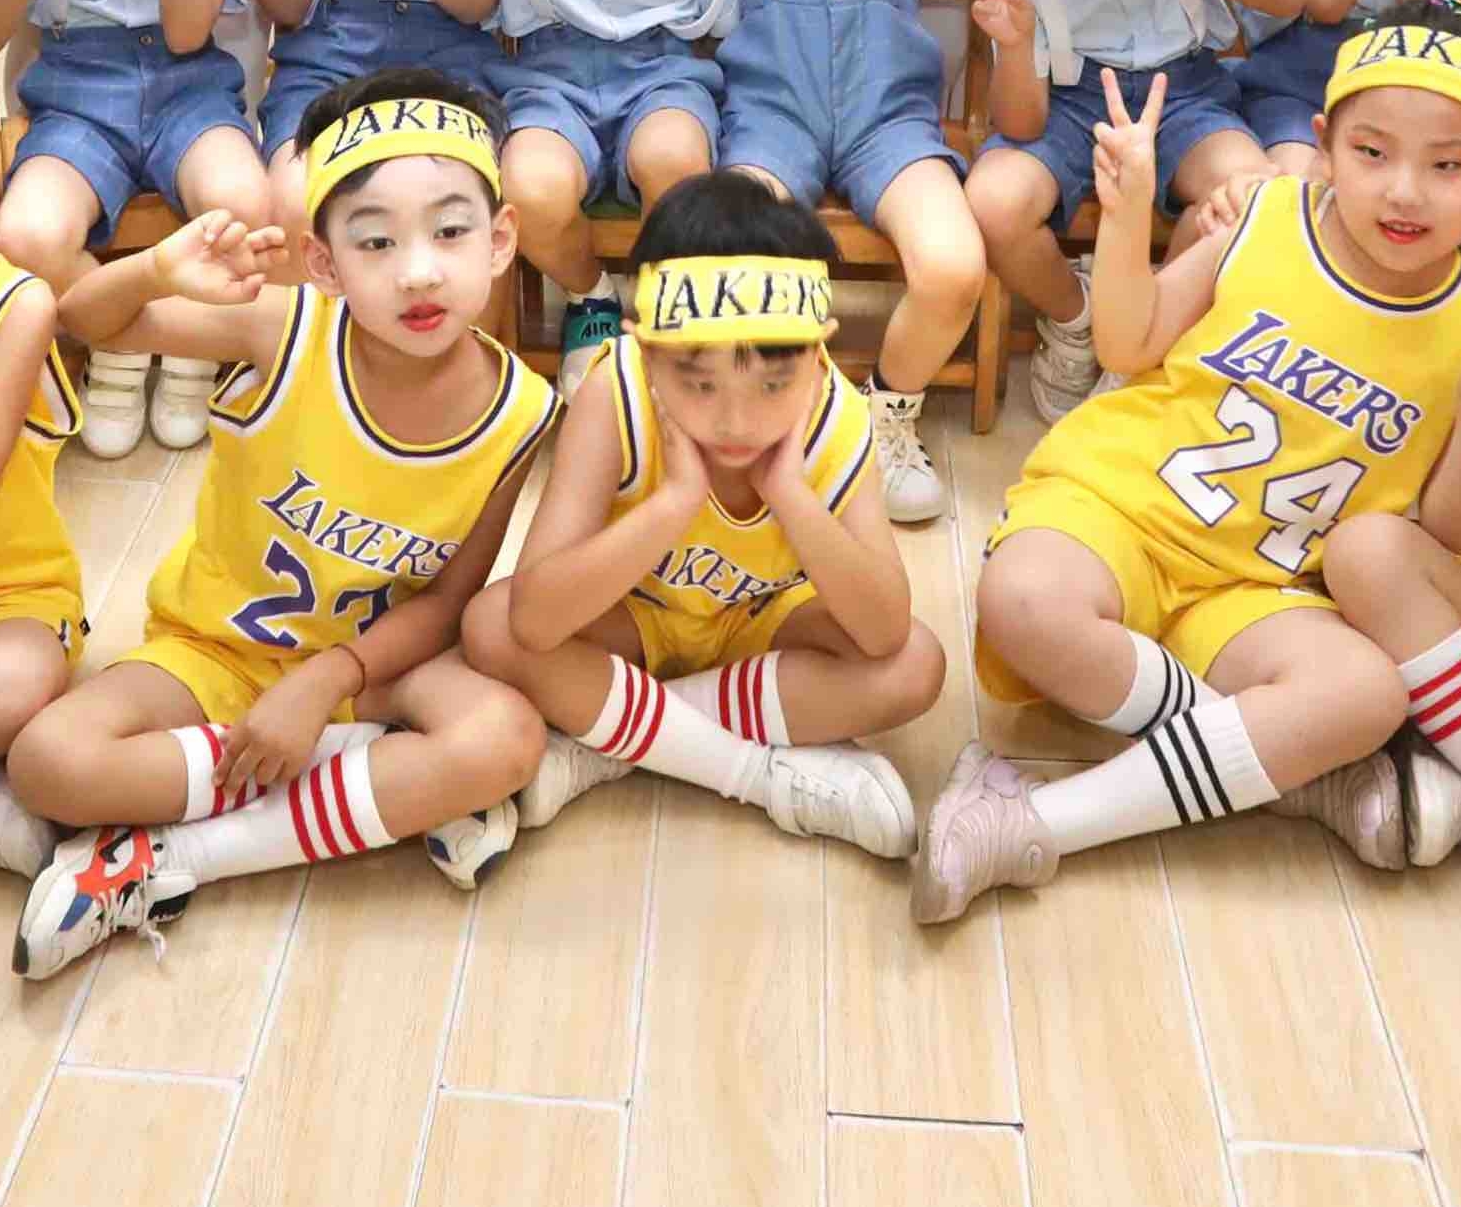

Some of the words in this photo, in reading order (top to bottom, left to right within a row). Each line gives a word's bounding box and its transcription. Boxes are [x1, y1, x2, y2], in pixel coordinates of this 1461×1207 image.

[580, 322, 614, 341] AIR
[652, 270, 832, 330] LAKERS
[1199, 309, 1424, 455] LAKERS
[260, 469, 461, 578] LAKERS
[1155, 382, 1370, 575] 24
